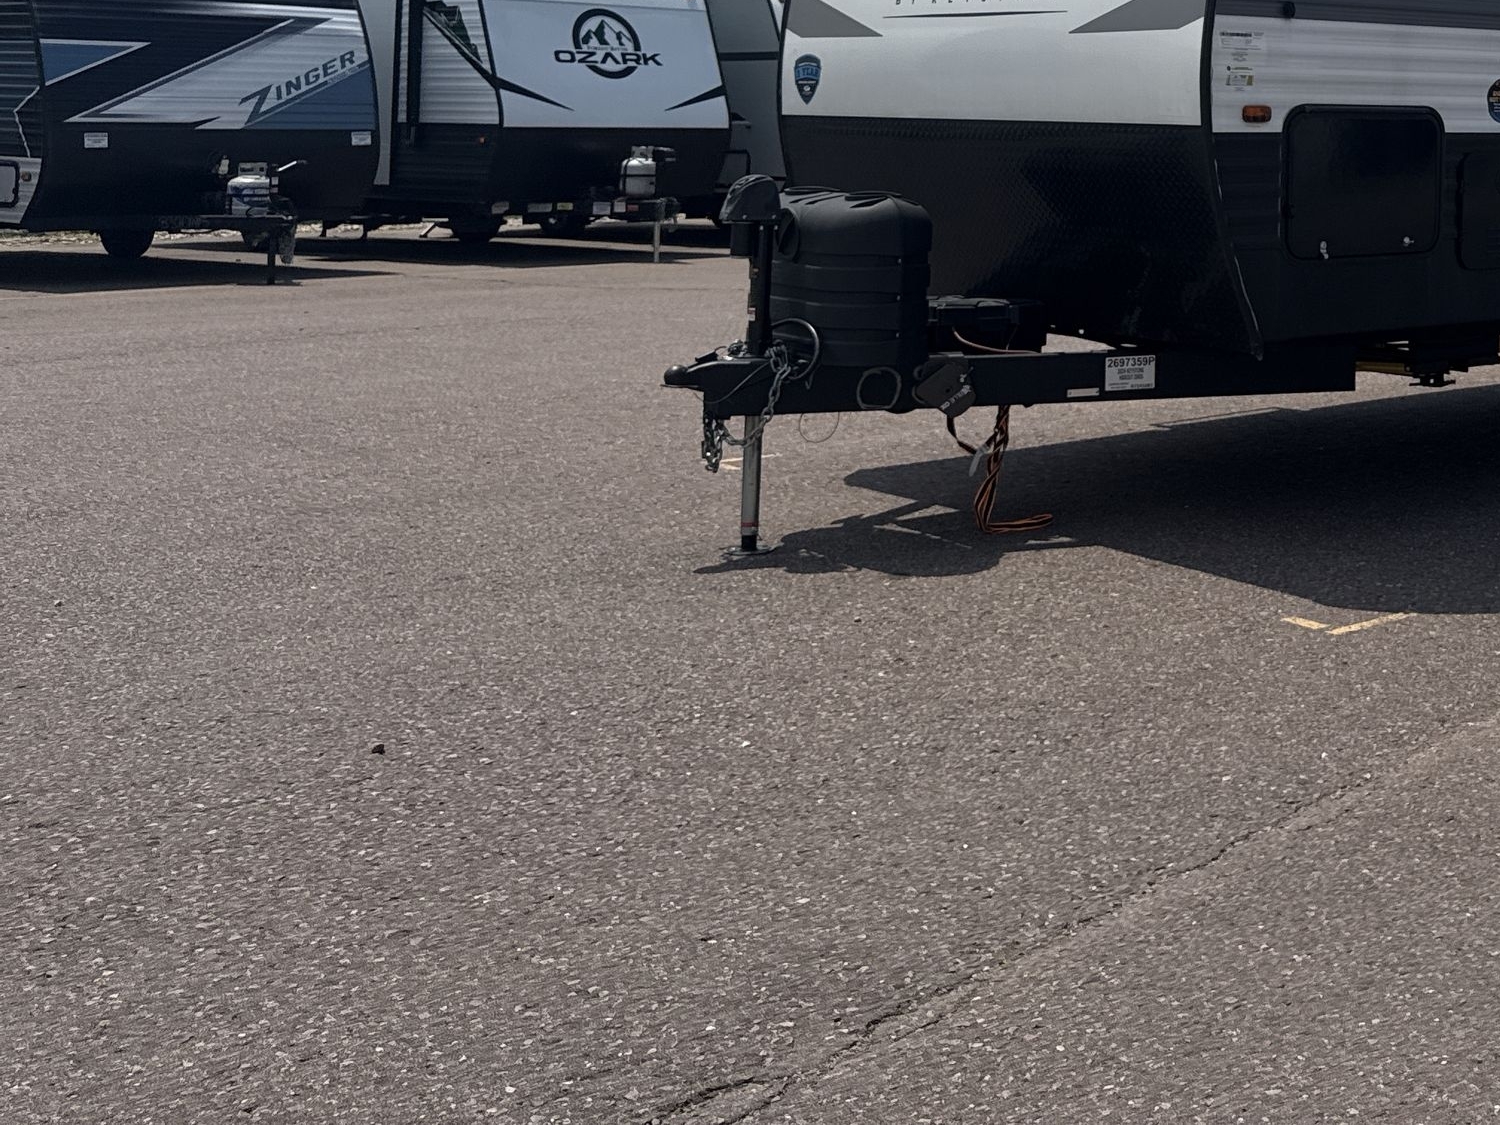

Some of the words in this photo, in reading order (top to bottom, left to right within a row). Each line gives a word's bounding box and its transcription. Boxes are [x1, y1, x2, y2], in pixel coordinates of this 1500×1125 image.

[553, 49, 663, 67] OZARK
[238, 50, 356, 126] ZINGER
[1107, 356, 1156, 369] 2697359P
